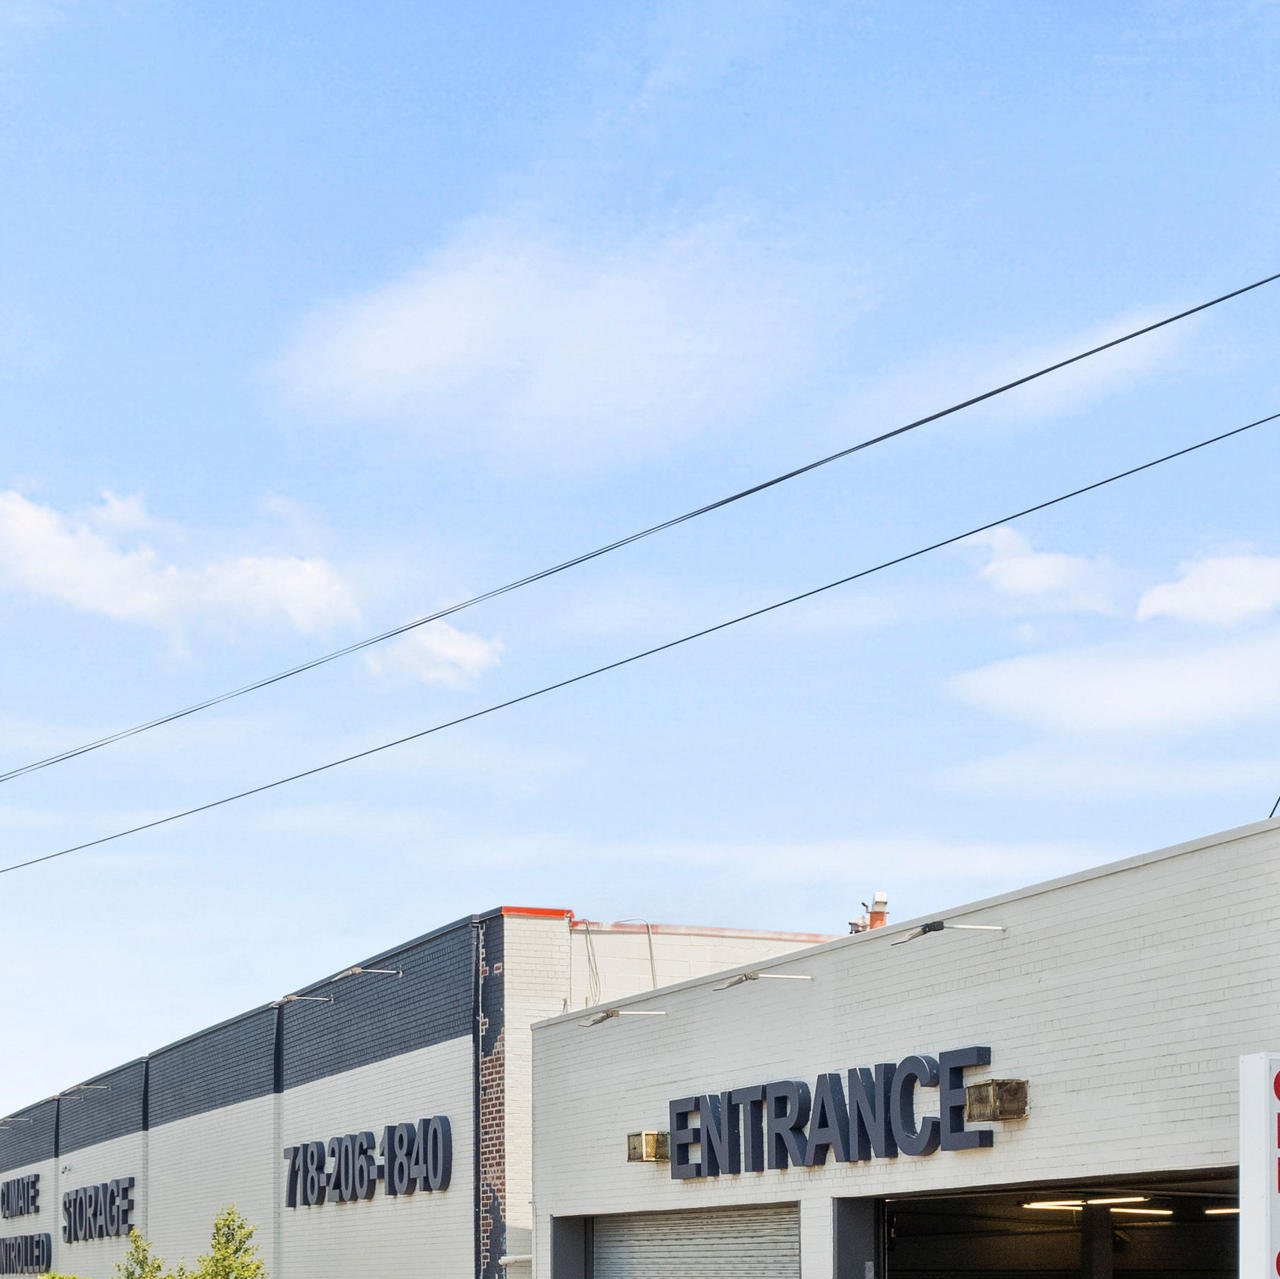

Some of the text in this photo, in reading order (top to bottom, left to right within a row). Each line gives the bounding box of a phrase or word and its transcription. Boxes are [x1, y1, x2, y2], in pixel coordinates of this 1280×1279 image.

[669, 1046, 994, 1181] ENTRANCE
[1, 1174, 40, 1219] CLIMATE
[283, 1115, 453, 1208] 718-206-1840
[62, 1176, 135, 1244] STORAGE
